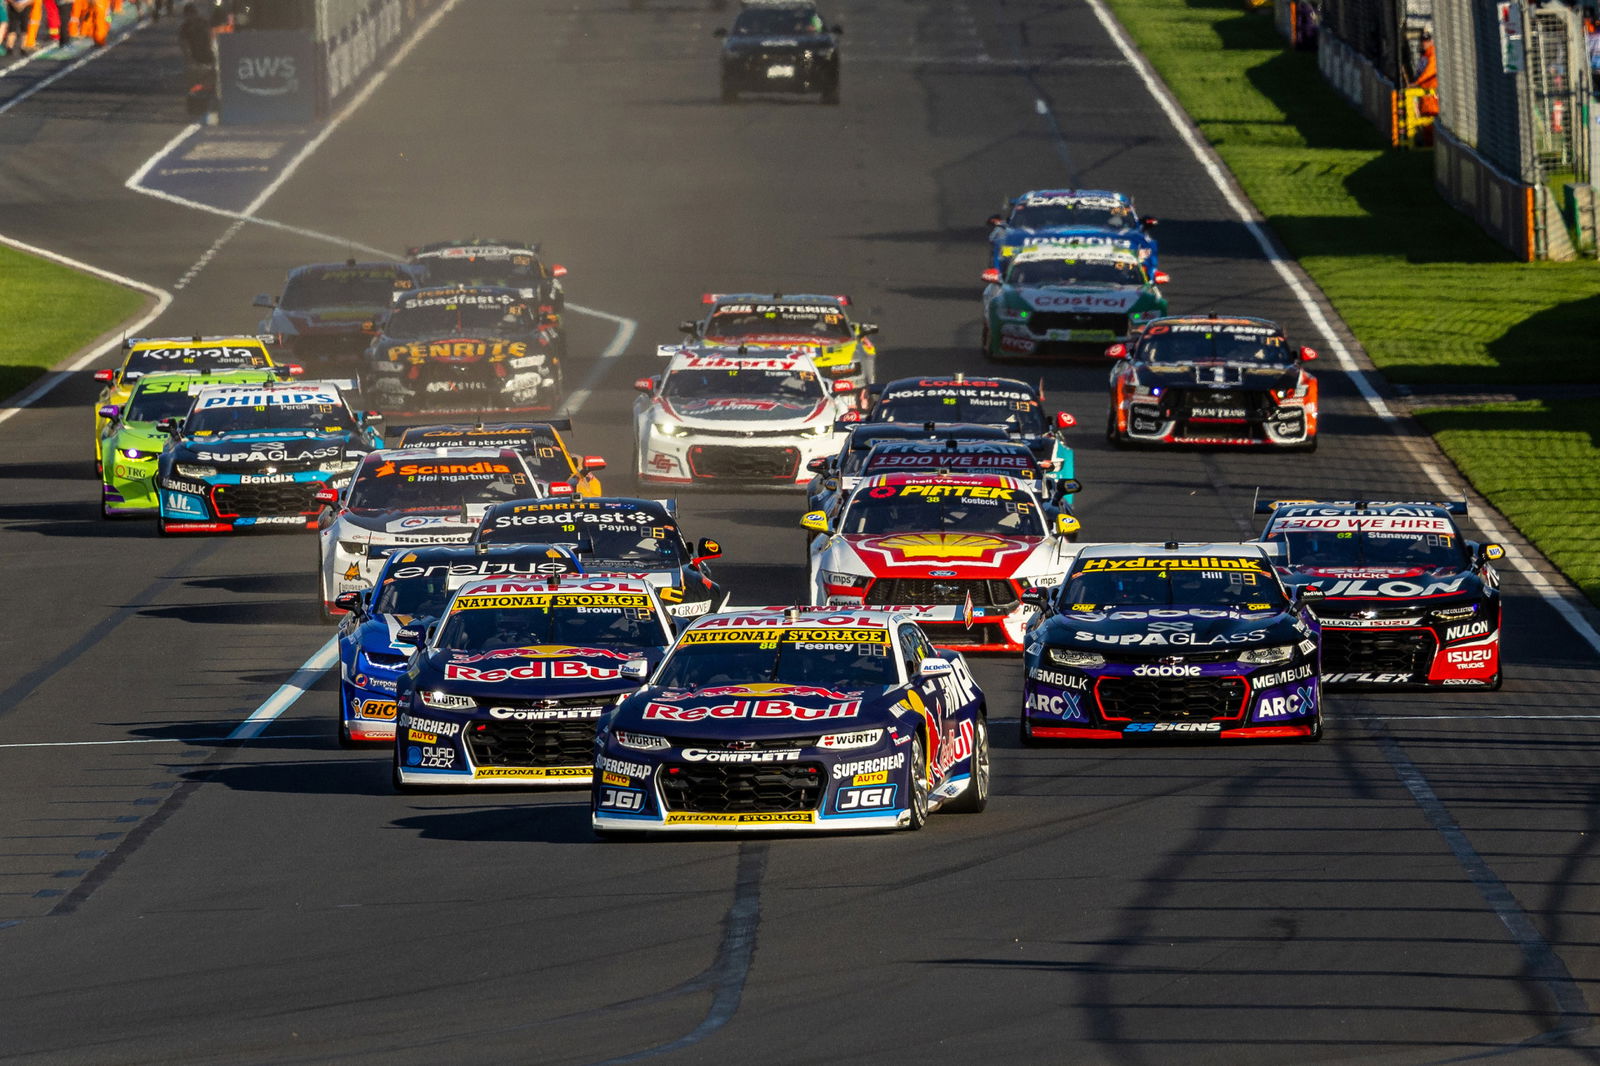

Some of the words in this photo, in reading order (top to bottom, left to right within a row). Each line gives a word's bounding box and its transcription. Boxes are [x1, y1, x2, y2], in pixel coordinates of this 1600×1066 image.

[239, 57, 296, 79] aws
[1034, 294, 1127, 308] Castrol
[142, 347, 252, 359] Kubota
[388, 340, 528, 364] PENRITE
[687, 357, 796, 370] Liberty
[204, 394, 336, 408] PHILIPS
[402, 440, 463, 449] Industrial
[196, 446, 339, 463] SUPAGLASS
[874, 455, 933, 466] 1300
[938, 456, 972, 466] WE
[978, 457, 1029, 467] HIRE
[127, 466, 147, 479] TRG
[399, 461, 510, 475] Scandia
[240, 474, 294, 484] Bendix
[408, 474, 415, 483] 8
[905, 478, 937, 486] Shell
[939, 479, 984, 487] V-Power
[900, 484, 1013, 500] PIRTEK
[513, 502, 602, 513] PENRITE
[961, 496, 999, 507] Kostecki
[495, 511, 624, 528] Steadfast
[1274, 518, 1341, 531] 1300
[1347, 518, 1384, 530] WE
[1390, 519, 1446, 531] HIRE
[561, 524, 576, 533] 19
[599, 523, 638, 533] Payne
[1336, 531, 1353, 540] 62
[1367, 531, 1424, 542] Stanaway
[394, 560, 568, 578] erebus
[1082, 556, 1261, 572] Hydraulink
[832, 573, 851, 585] mps
[1040, 576, 1057, 587] mps
[1158, 571, 1168, 581] 4
[1202, 570, 1223, 581] Hill
[465, 582, 644, 595] AMPOL
[456, 596, 547, 610] NATIONAL
[556, 595, 644, 608] STORAGE
[677, 602, 709, 617] GROVE
[576, 606, 622, 615] Brown
[695, 615, 886, 629] AMPOL
[1370, 618, 1410, 627] ISUZU
[684, 630, 779, 645] NATIONAL
[789, 629, 884, 643] STORAGE
[1075, 629, 1267, 645] SUPAGLASS
[1446, 620, 1489, 641] NULON
[759, 641, 777, 649] 88
[795, 641, 854, 653] Feeney
[1447, 649, 1492, 663] ISUZU
[444, 661, 547, 684] Red
[1132, 663, 1203, 678] dabble
[1456, 662, 1486, 670] TRUCKS
[1028, 666, 1087, 691] MGMBULK
[1253, 663, 1314, 691] MGMBULK
[1024, 690, 1081, 720] ARCX
[1258, 686, 1315, 719] ARCX
[490, 706, 603, 720] COMPLETE
[643, 701, 752, 723] Red
[754, 699, 864, 721] Bull
[398, 711, 461, 738] SUPERCHEAP
[411, 730, 436, 742] AUTO
[626, 731, 665, 748] WÜRTH
[836, 731, 878, 745] WÜRTH
[421, 745, 456, 758] QUAD
[682, 747, 801, 762] COMPLETE
[421, 757, 454, 768] LOCK
[595, 753, 653, 781] SUPERCHEAP
[832, 752, 906, 779] SUPERCHEAP
[476, 768, 544, 778] NATIONAL
[605, 773, 629, 785] AUTO
[856, 772, 885, 784] AUTO
[601, 790, 642, 810] JGI
[842, 788, 893, 810] JGI
[667, 813, 738, 823] NATIONAL
[742, 811, 814, 822] STORAGE
